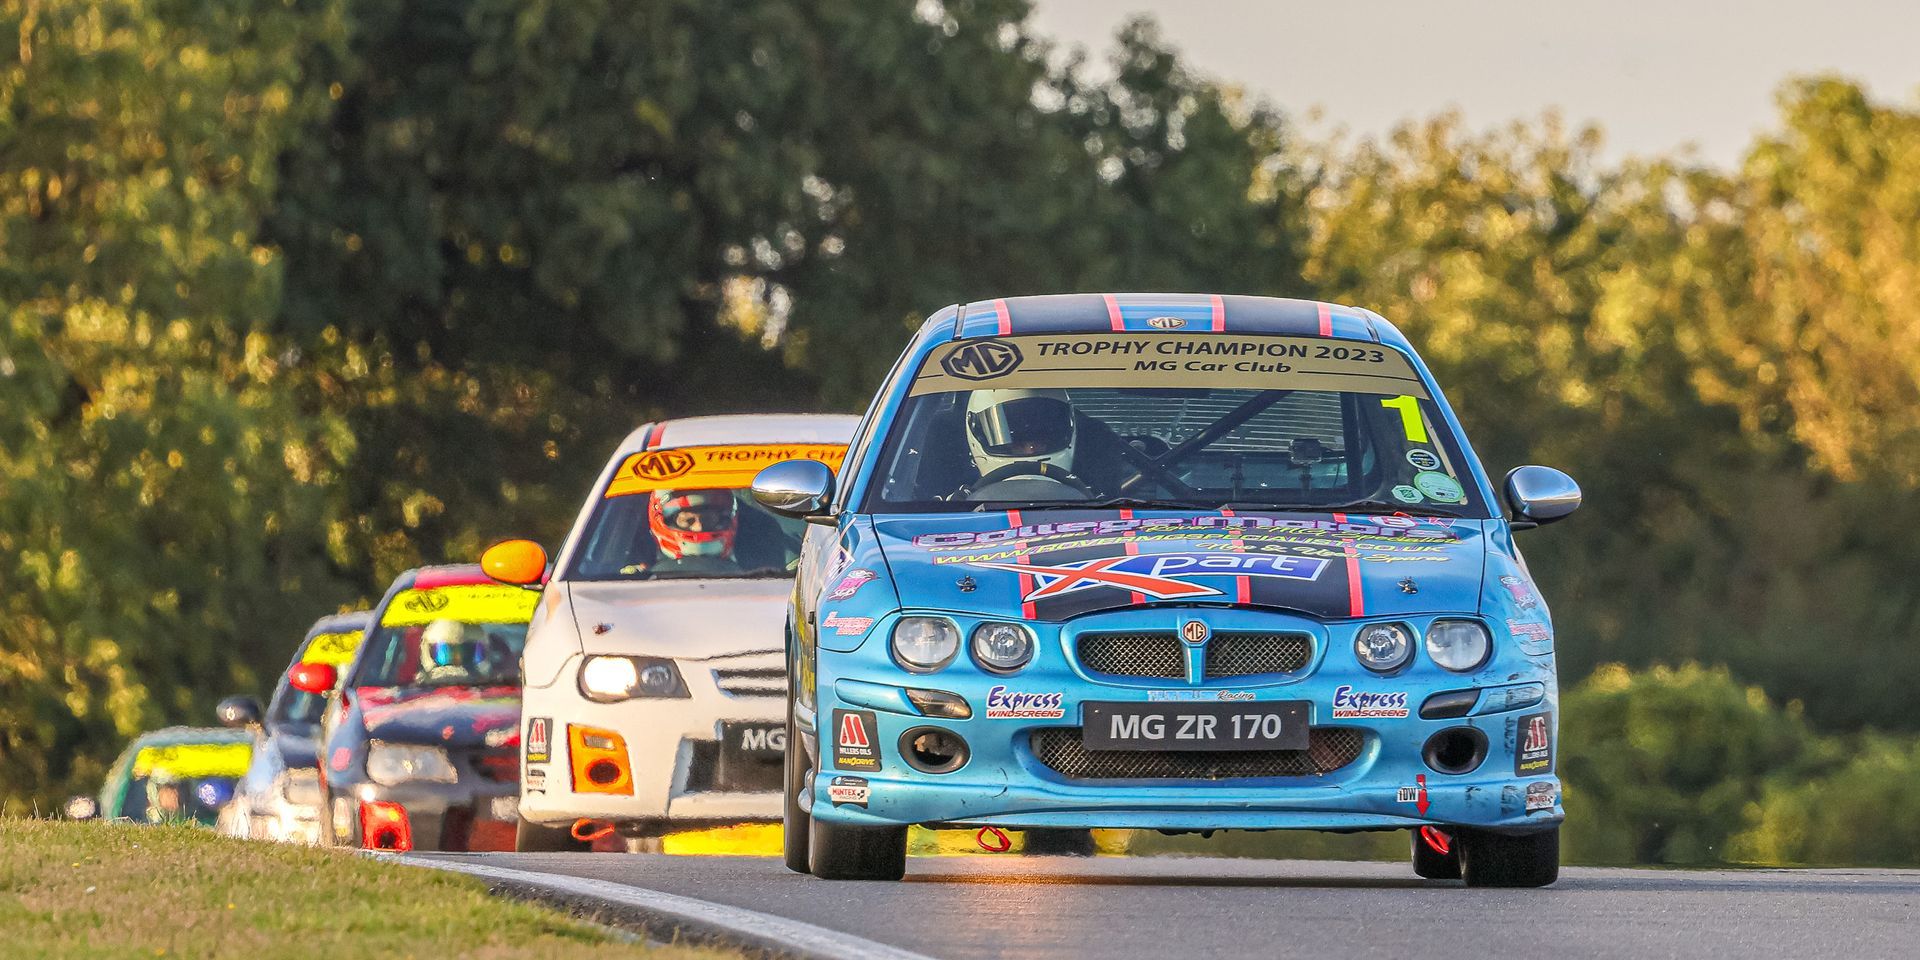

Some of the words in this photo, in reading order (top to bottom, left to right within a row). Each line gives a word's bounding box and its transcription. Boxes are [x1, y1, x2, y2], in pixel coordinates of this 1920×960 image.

[1037, 340, 1152, 358] TROPHY
[1154, 341, 1308, 359] CHAMPION
[1314, 345, 1386, 364] 2023
[1132, 360, 1178, 373] MG
[1183, 360, 1230, 373] Car
[1234, 360, 1293, 374] Club
[1380, 395, 1429, 444] 1
[703, 450, 798, 462] TROPHY
[987, 685, 1063, 713] Express
[1334, 686, 1407, 713] Express
[987, 709, 1065, 718] WINDSCREENS
[1333, 709, 1408, 718] WINDSCREENS
[1110, 714, 1166, 740] MG
[1175, 714, 1217, 740] ZR
[1231, 714, 1283, 740] 170
[832, 788, 857, 797] MINTEX
